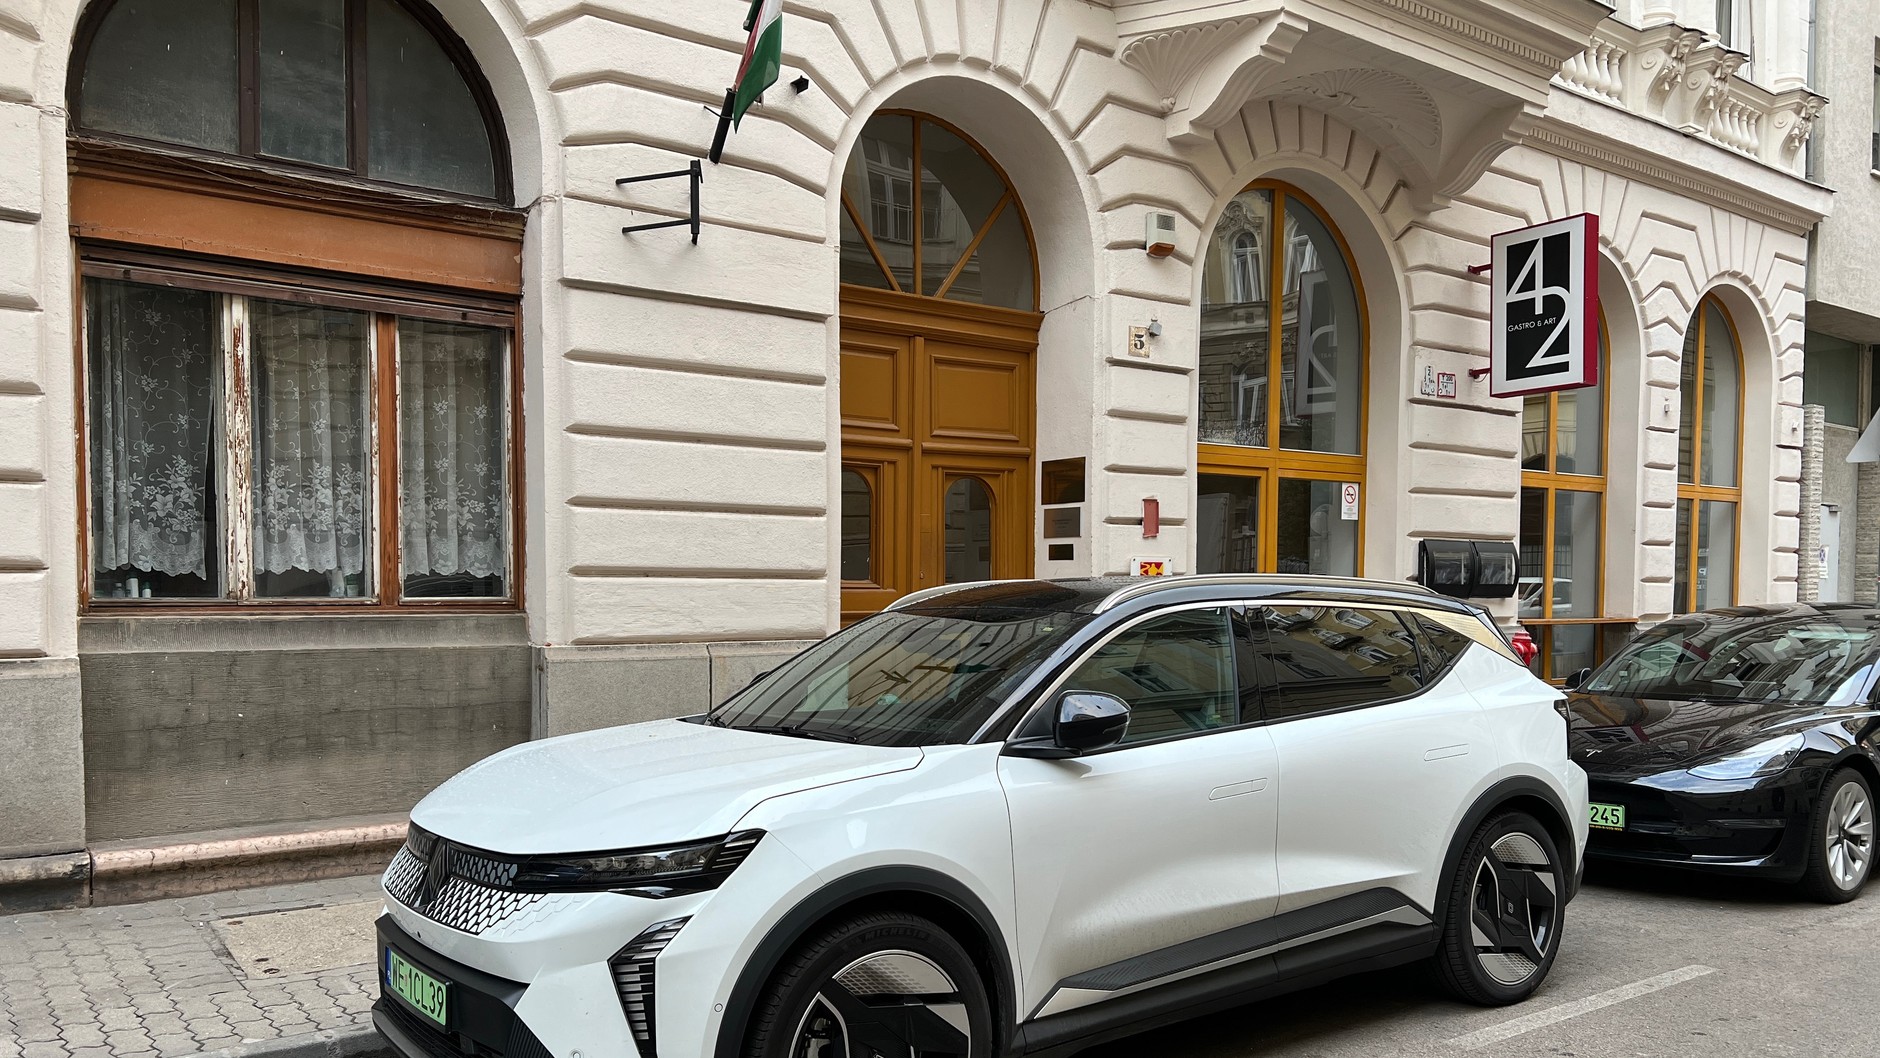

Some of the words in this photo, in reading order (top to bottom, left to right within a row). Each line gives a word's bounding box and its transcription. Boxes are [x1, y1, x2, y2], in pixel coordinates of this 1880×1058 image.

[1507, 321, 1536, 332] GASTRO
[1543, 317, 1557, 326] ART
[1134, 333, 1145, 350] 5
[1590, 806, 1620, 825] 245
[864, 926, 928, 939] MICHELIN
